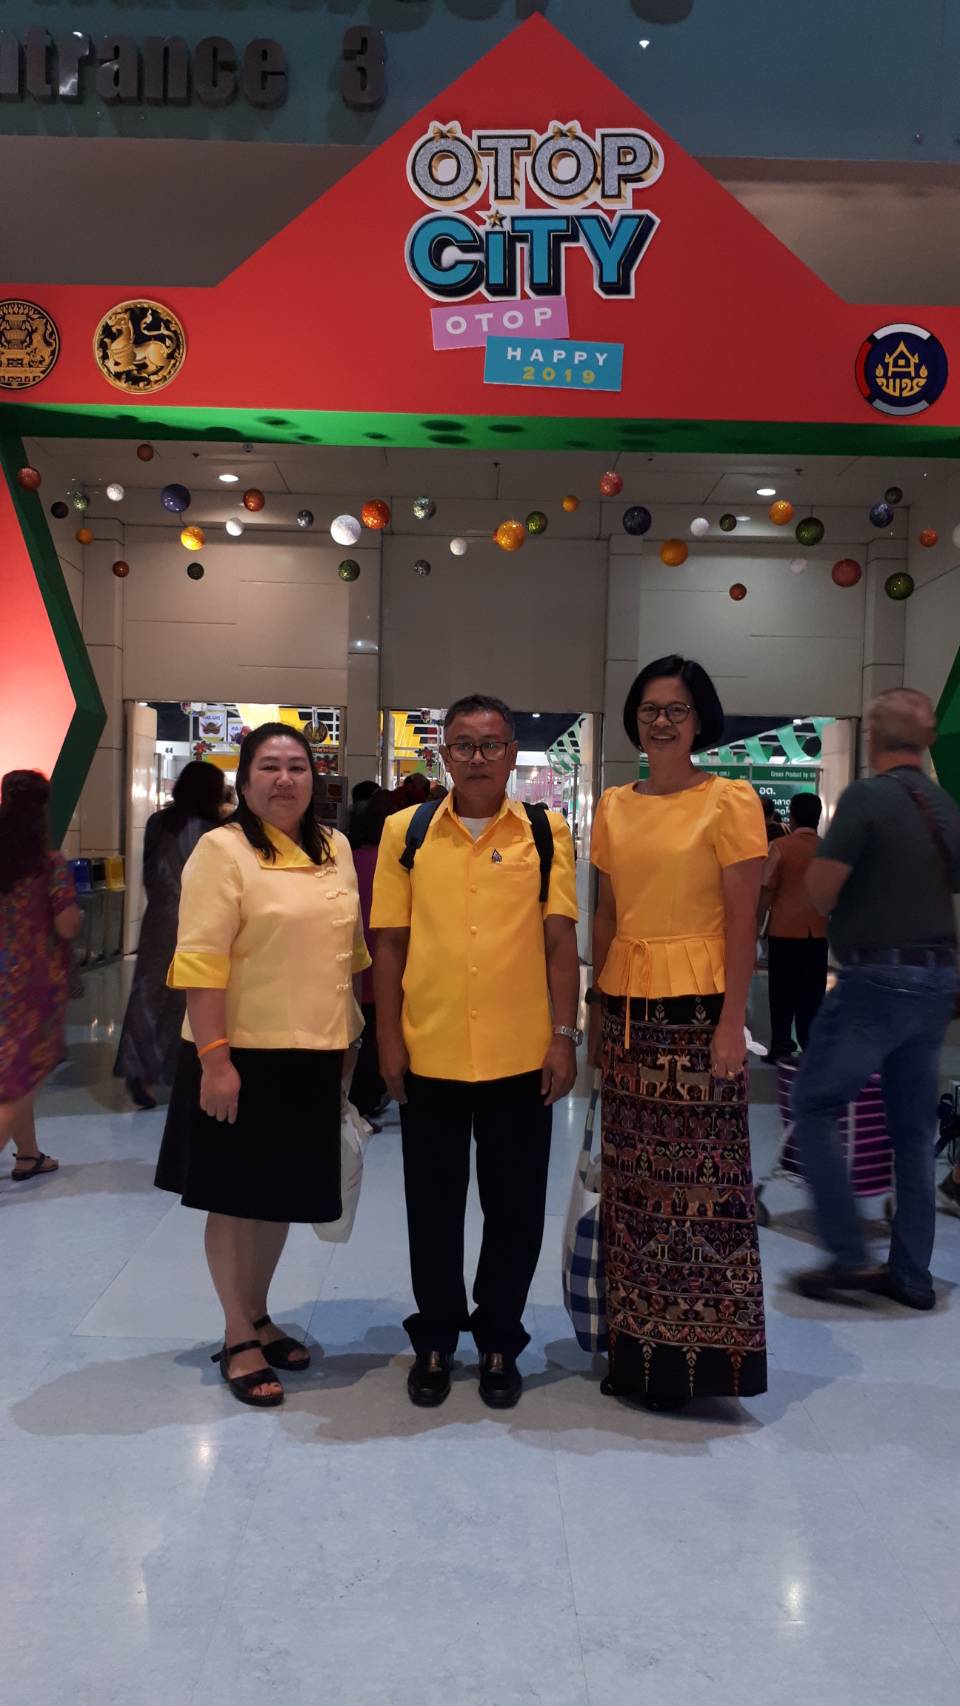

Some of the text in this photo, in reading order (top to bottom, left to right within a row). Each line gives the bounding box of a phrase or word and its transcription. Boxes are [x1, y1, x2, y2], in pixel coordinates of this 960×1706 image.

[341, 25, 386, 111] 3
[409, 124, 662, 208] OTOP
[446, 307, 552, 334] OTOP
[506, 346, 608, 366] HAPPY
[522, 366, 596, 384] 2019
